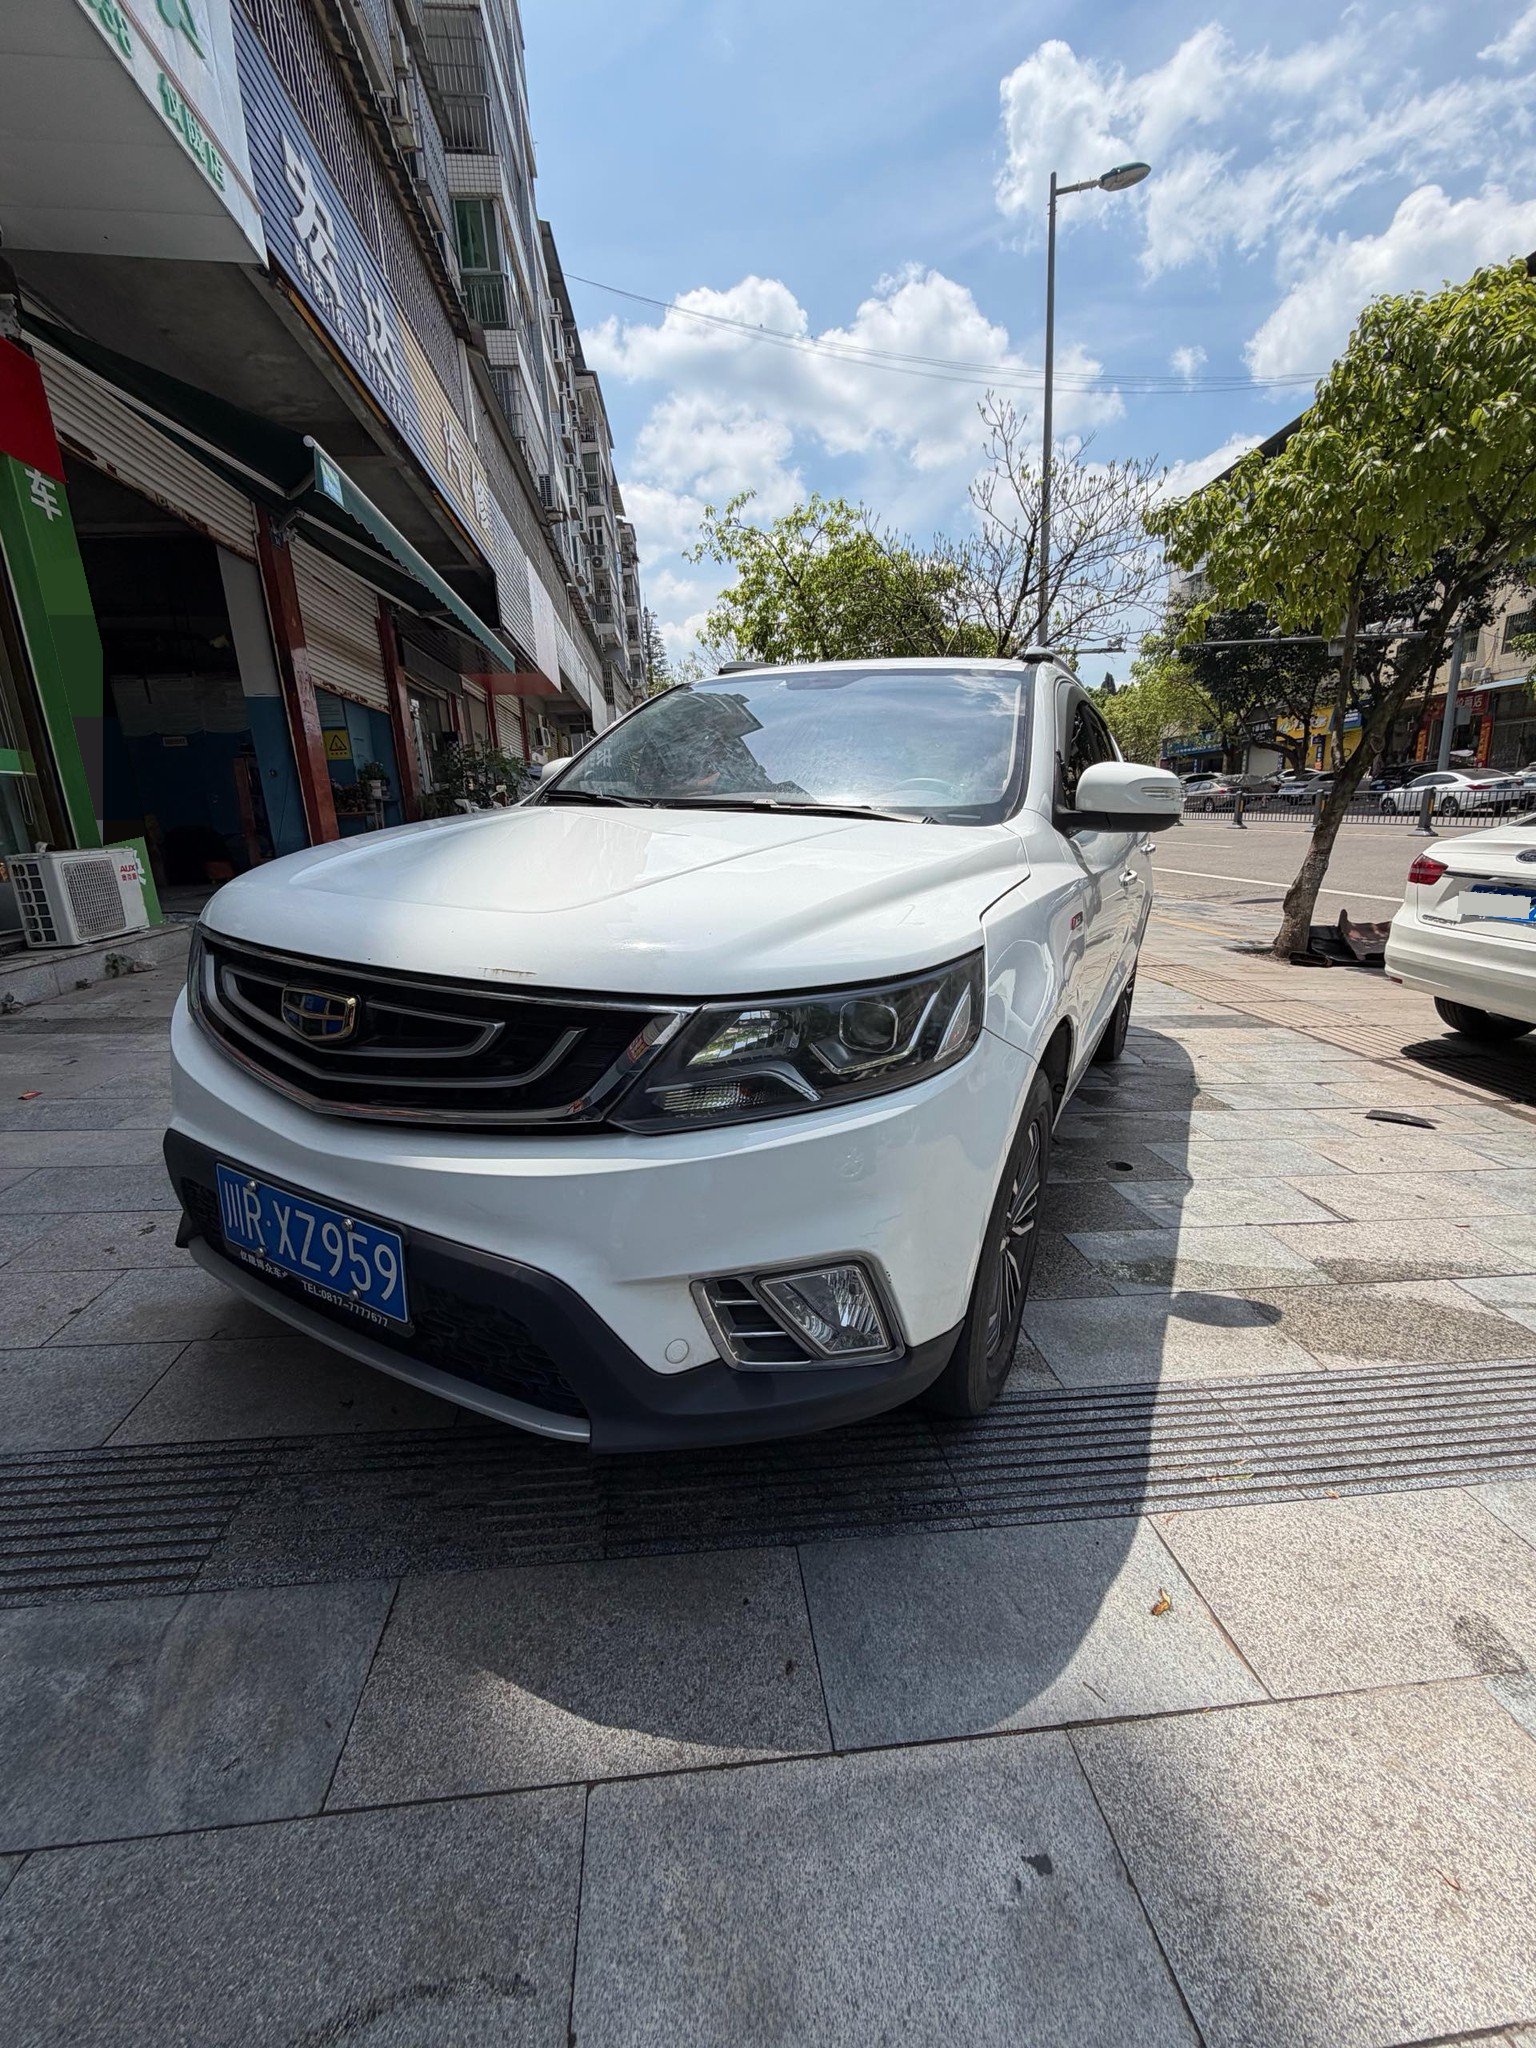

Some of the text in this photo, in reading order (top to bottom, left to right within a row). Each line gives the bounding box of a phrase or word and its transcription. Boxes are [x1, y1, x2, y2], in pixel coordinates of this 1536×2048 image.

[281, 131, 401, 395] 宏达
[24, 468, 63, 522] 车
[120, 864, 136, 873] AUX
